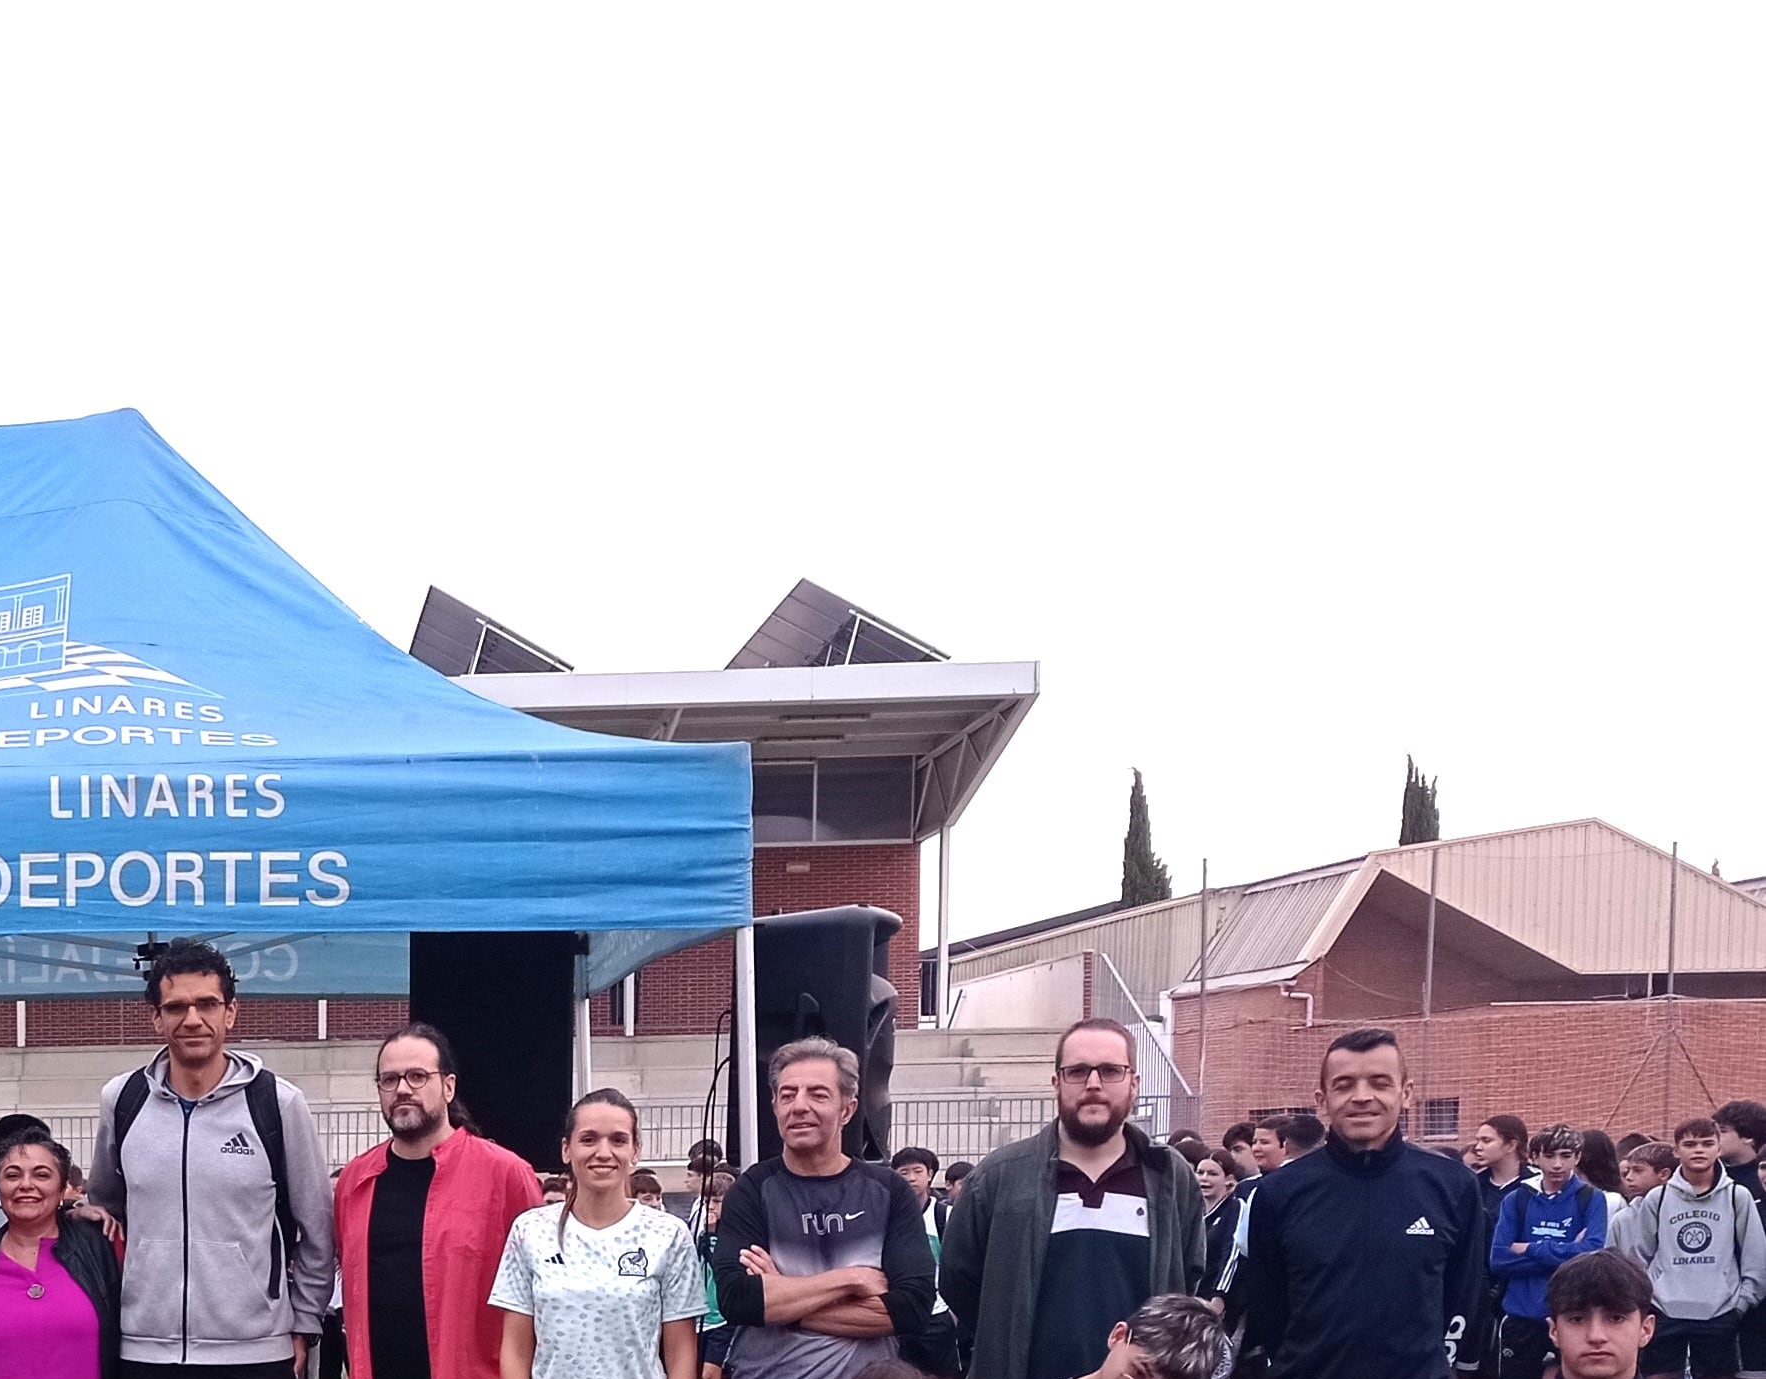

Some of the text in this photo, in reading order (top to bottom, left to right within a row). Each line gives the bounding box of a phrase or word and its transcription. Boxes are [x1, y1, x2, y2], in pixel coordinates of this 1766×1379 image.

[29, 694, 225, 723] LINARES
[49, 772, 287, 820] LINARES
[220, 1146, 255, 1155] adidas
[801, 1212, 844, 1235] run
[1669, 1210, 1721, 1225] COLEGIO
